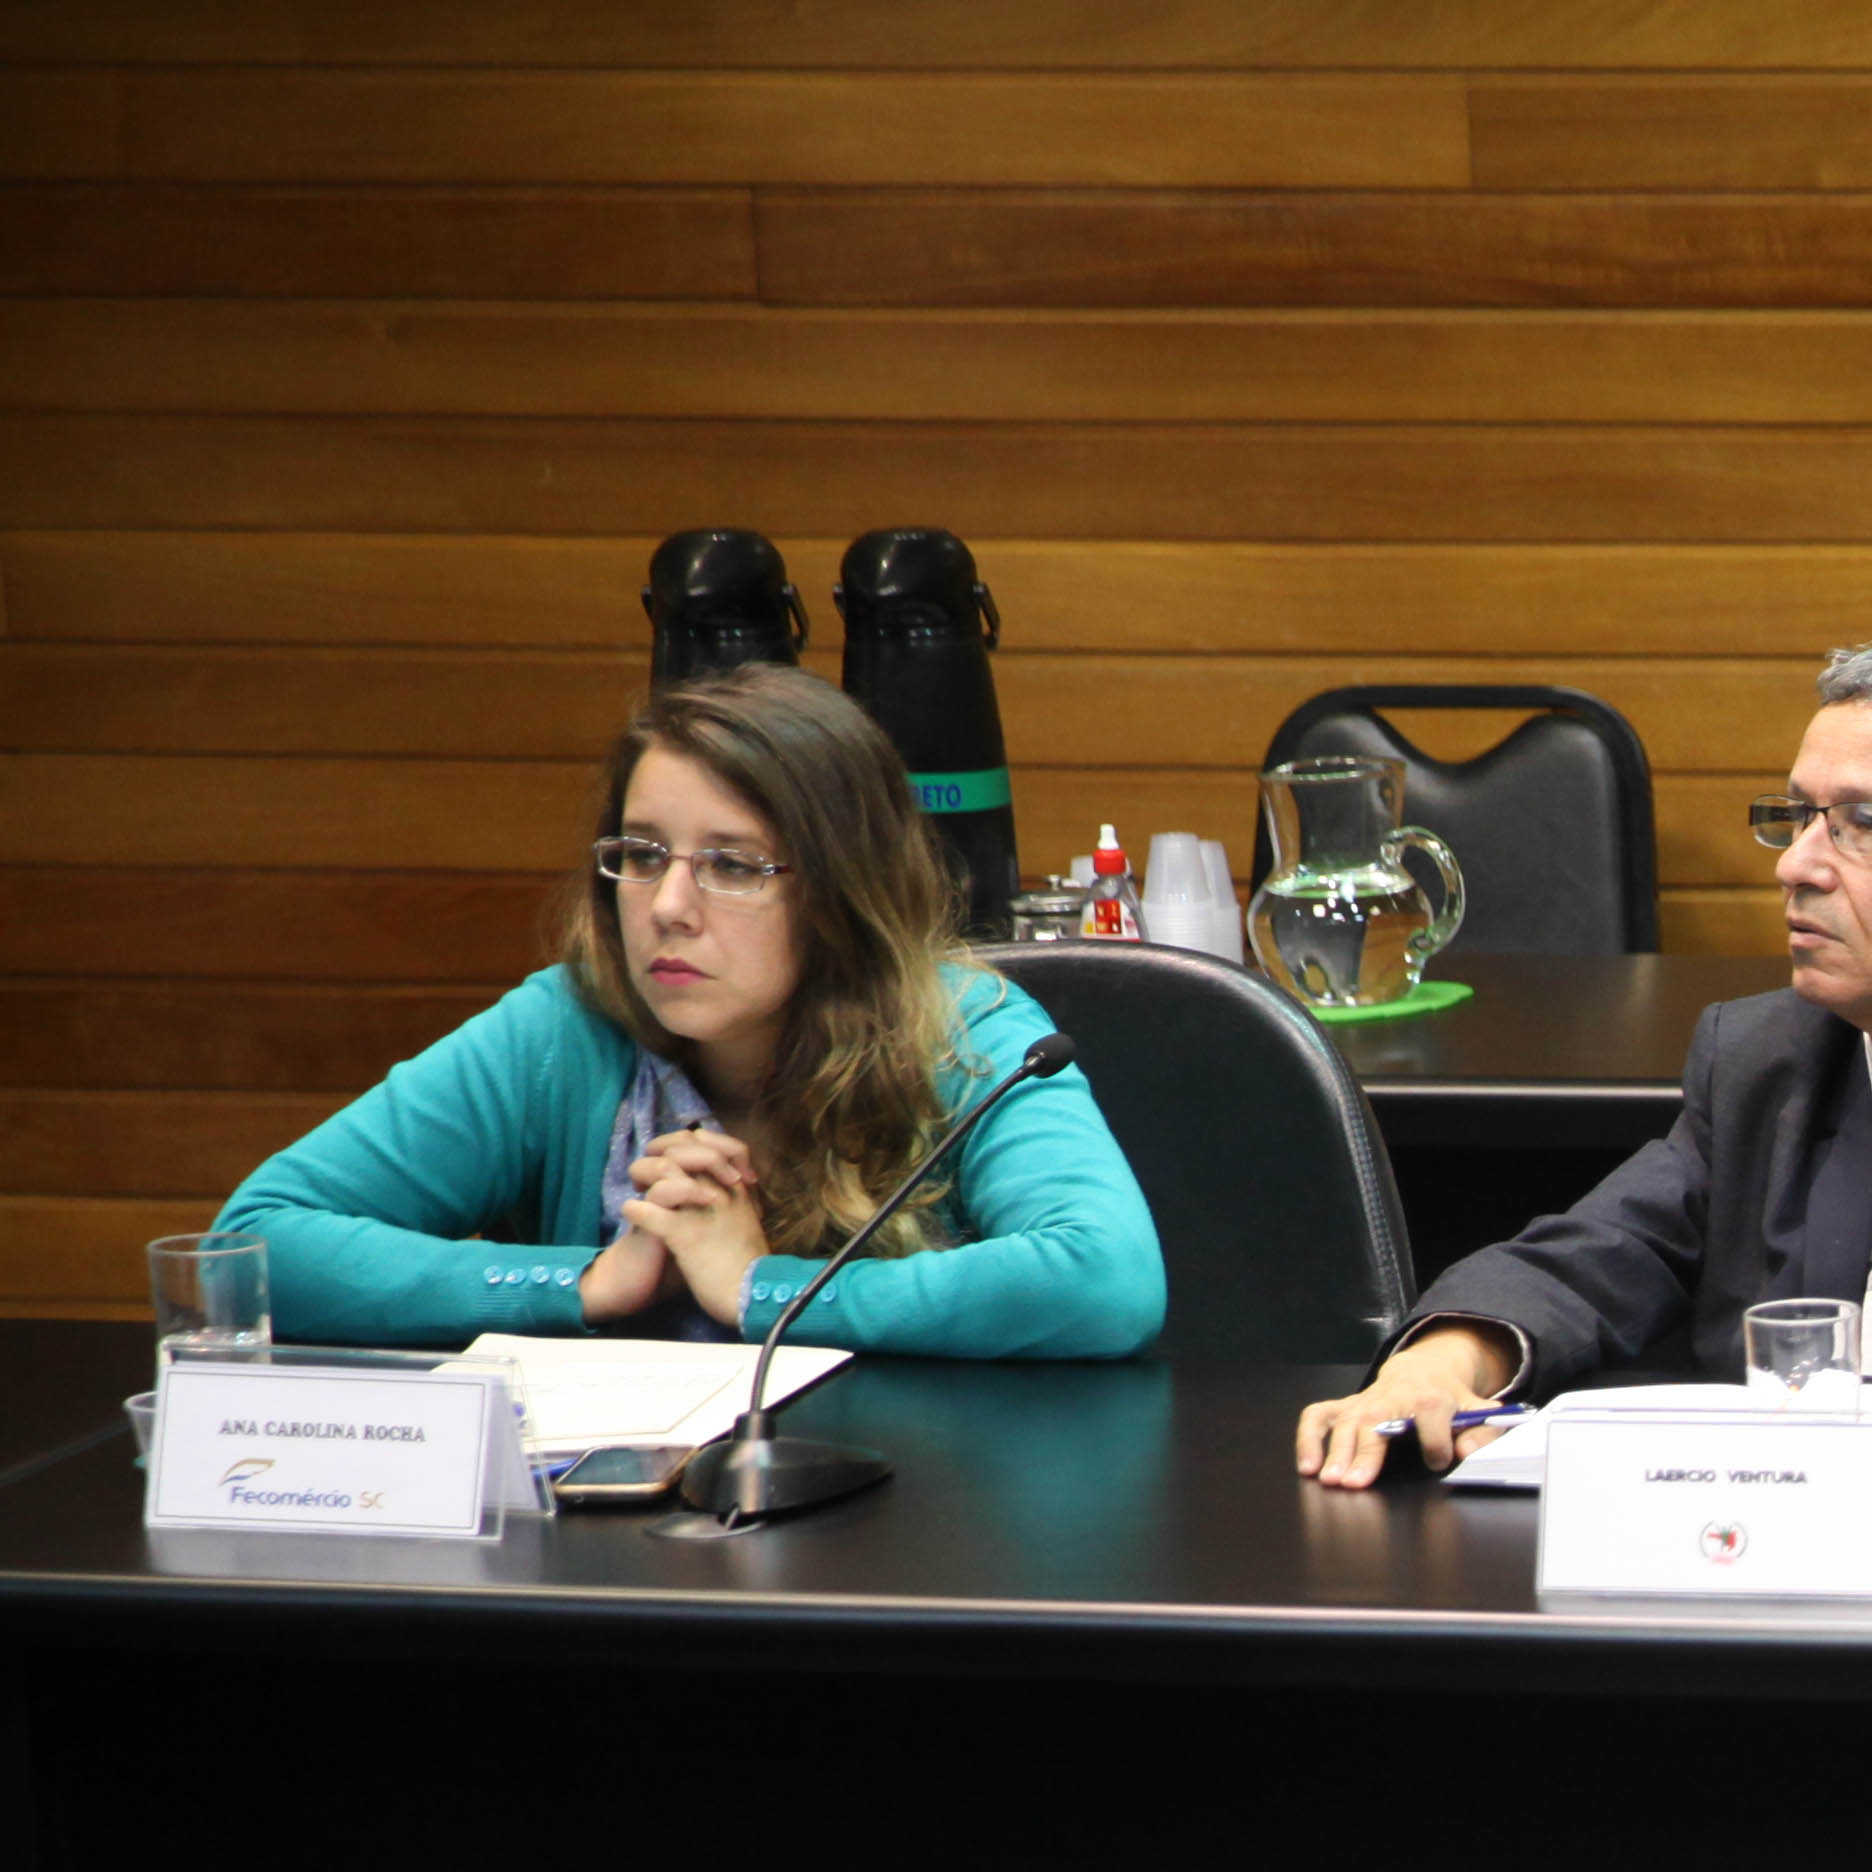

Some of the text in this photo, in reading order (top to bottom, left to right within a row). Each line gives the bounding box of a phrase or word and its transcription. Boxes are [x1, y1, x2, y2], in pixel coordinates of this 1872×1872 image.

[218, 1418, 426, 1443] ANA CAROLINA ROCHA
[1644, 1468, 1808, 1486] LAERCIO VENTURA
[229, 1486, 352, 1509] Fecomércio
